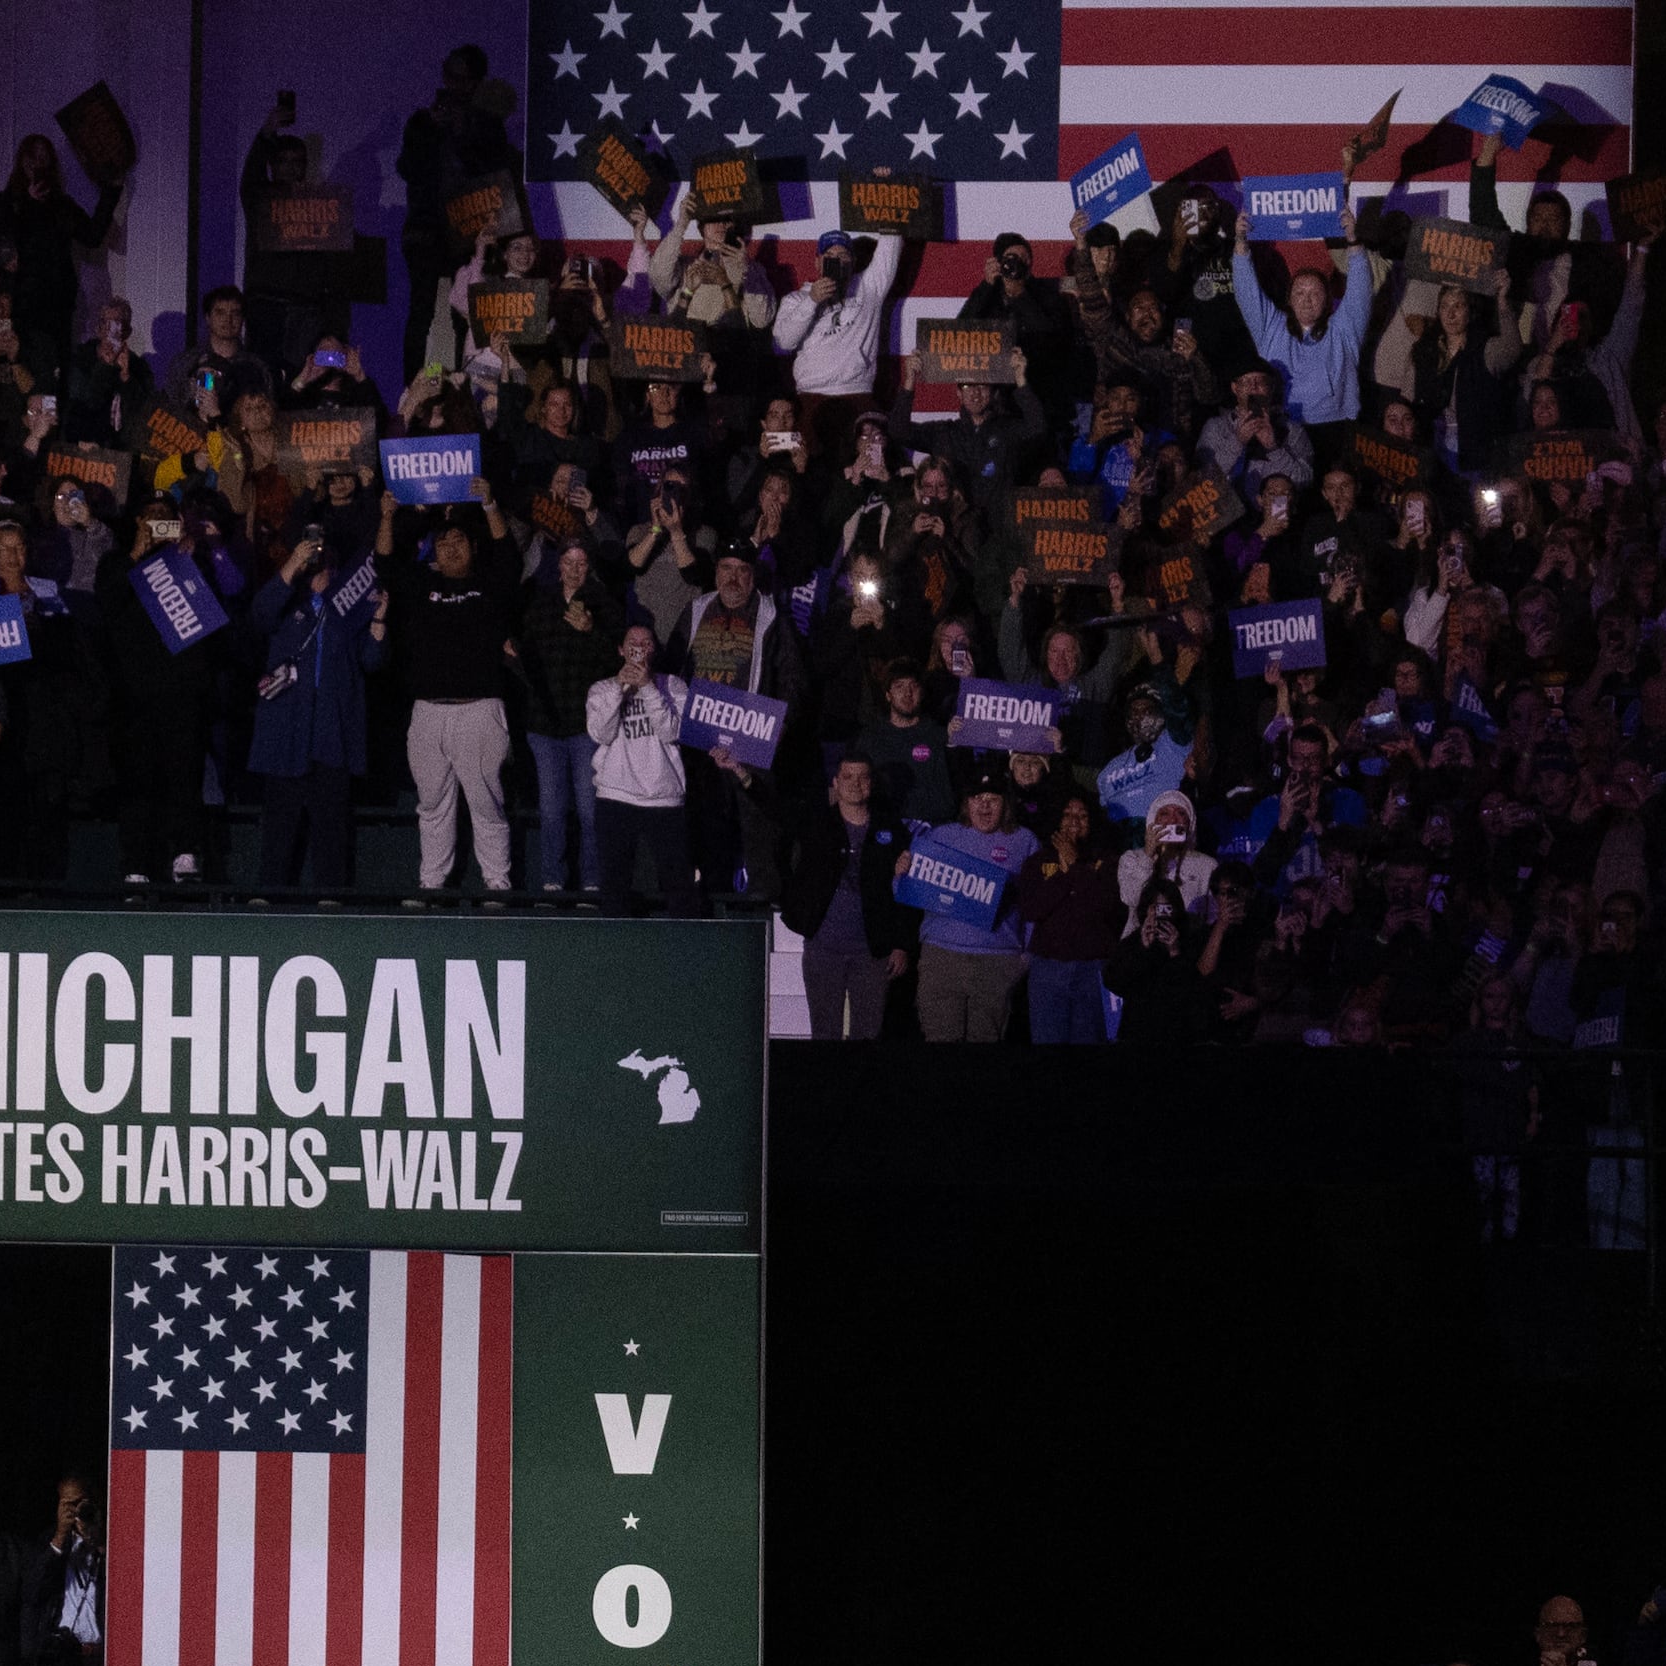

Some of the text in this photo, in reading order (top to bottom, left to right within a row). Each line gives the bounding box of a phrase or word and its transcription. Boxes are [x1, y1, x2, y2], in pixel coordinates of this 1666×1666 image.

[695, 160, 746, 187] HARRIS
[1077, 147, 1140, 206] FREEDOM
[852, 182, 920, 208] HARRIS
[1251, 187, 1337, 216] FREEDOM
[476, 293, 535, 318] HARRIS
[624, 323, 693, 353] HARRIS
[930, 330, 1002, 354] HARRIS
[292, 419, 362, 444] HARRIS
[388, 449, 473, 480] FREEDOM
[1016, 499, 1090, 521] HARRIS
[1034, 530, 1108, 557] HARRIS
[1045, 558, 1095, 572] WALZ
[142, 557, 203, 640] FREEDOM
[1237, 615, 1317, 650] FREEDOM
[690, 694, 775, 740] FREEDOM
[964, 693, 1051, 726] FREEDOM
[908, 854, 996, 905] FREEDOM
[101, 1124, 524, 1213] HARRIS-WALZ
